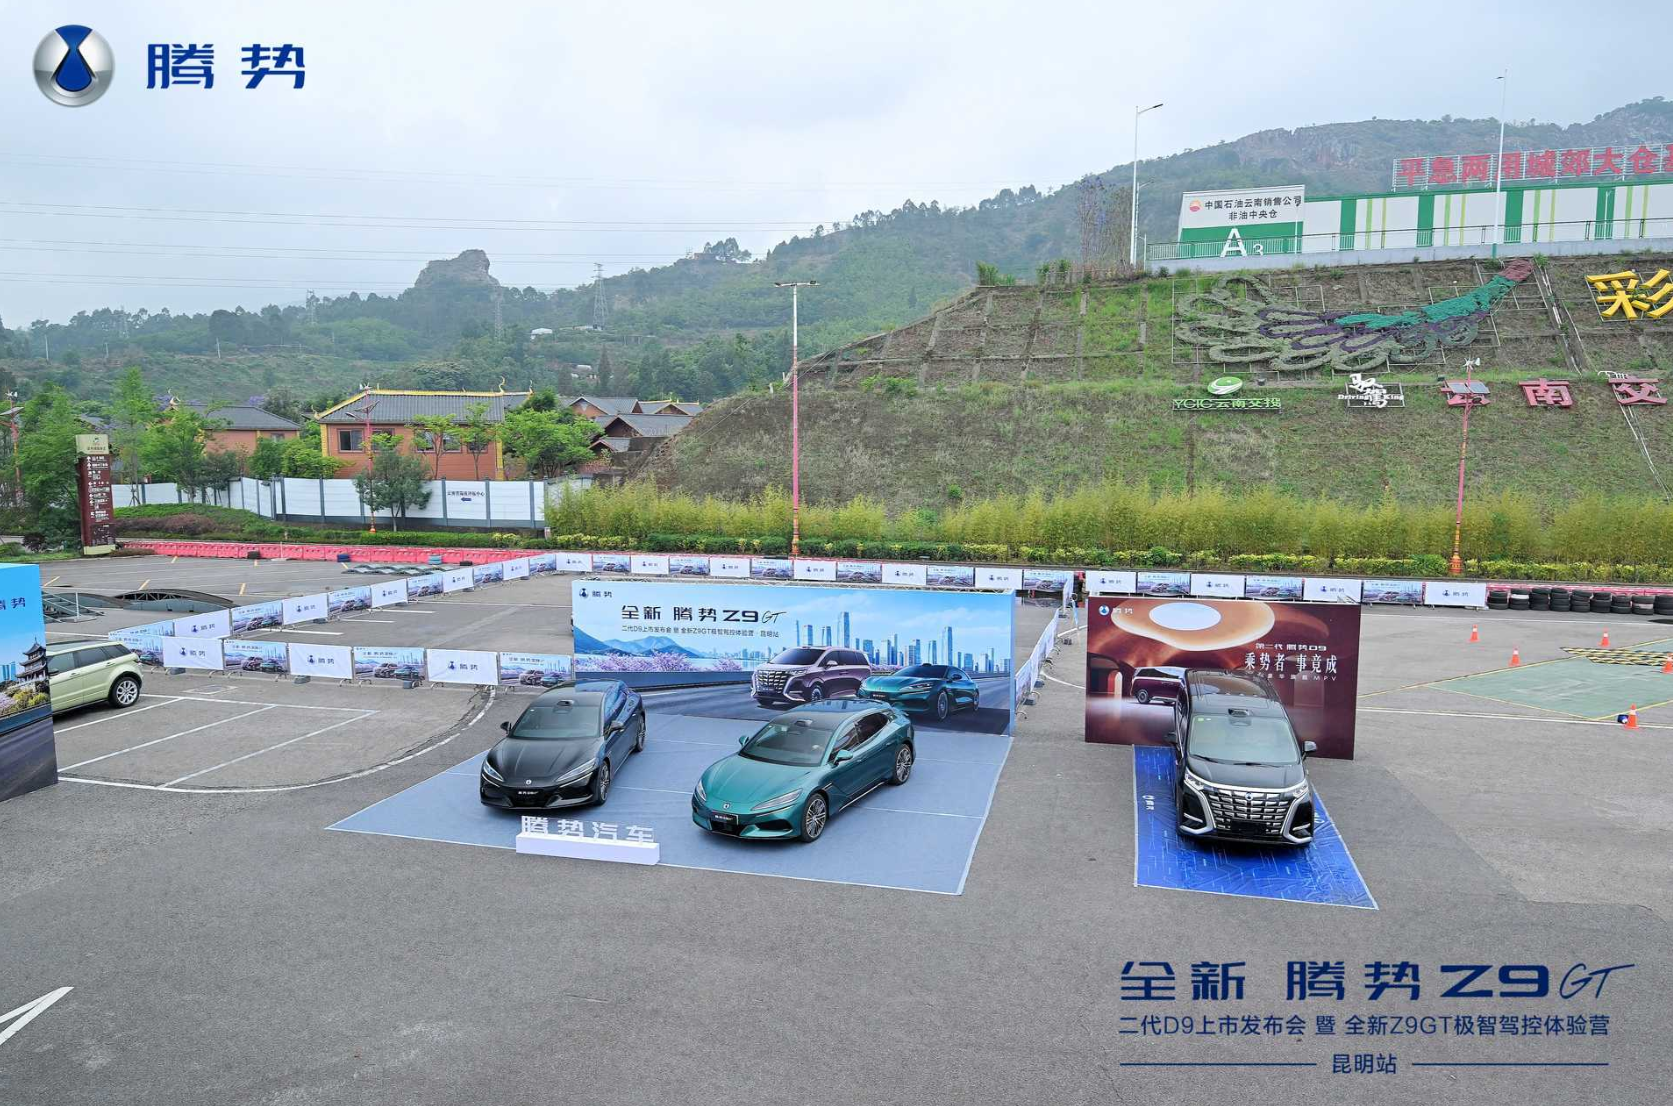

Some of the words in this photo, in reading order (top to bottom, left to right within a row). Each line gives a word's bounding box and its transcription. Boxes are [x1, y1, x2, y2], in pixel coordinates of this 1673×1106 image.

[1204, 195, 1302, 210] 中国石油云南销售公司
[1228, 209, 1278, 220] 非油中央仓
[521, 815, 655, 843] 腾势汽车
